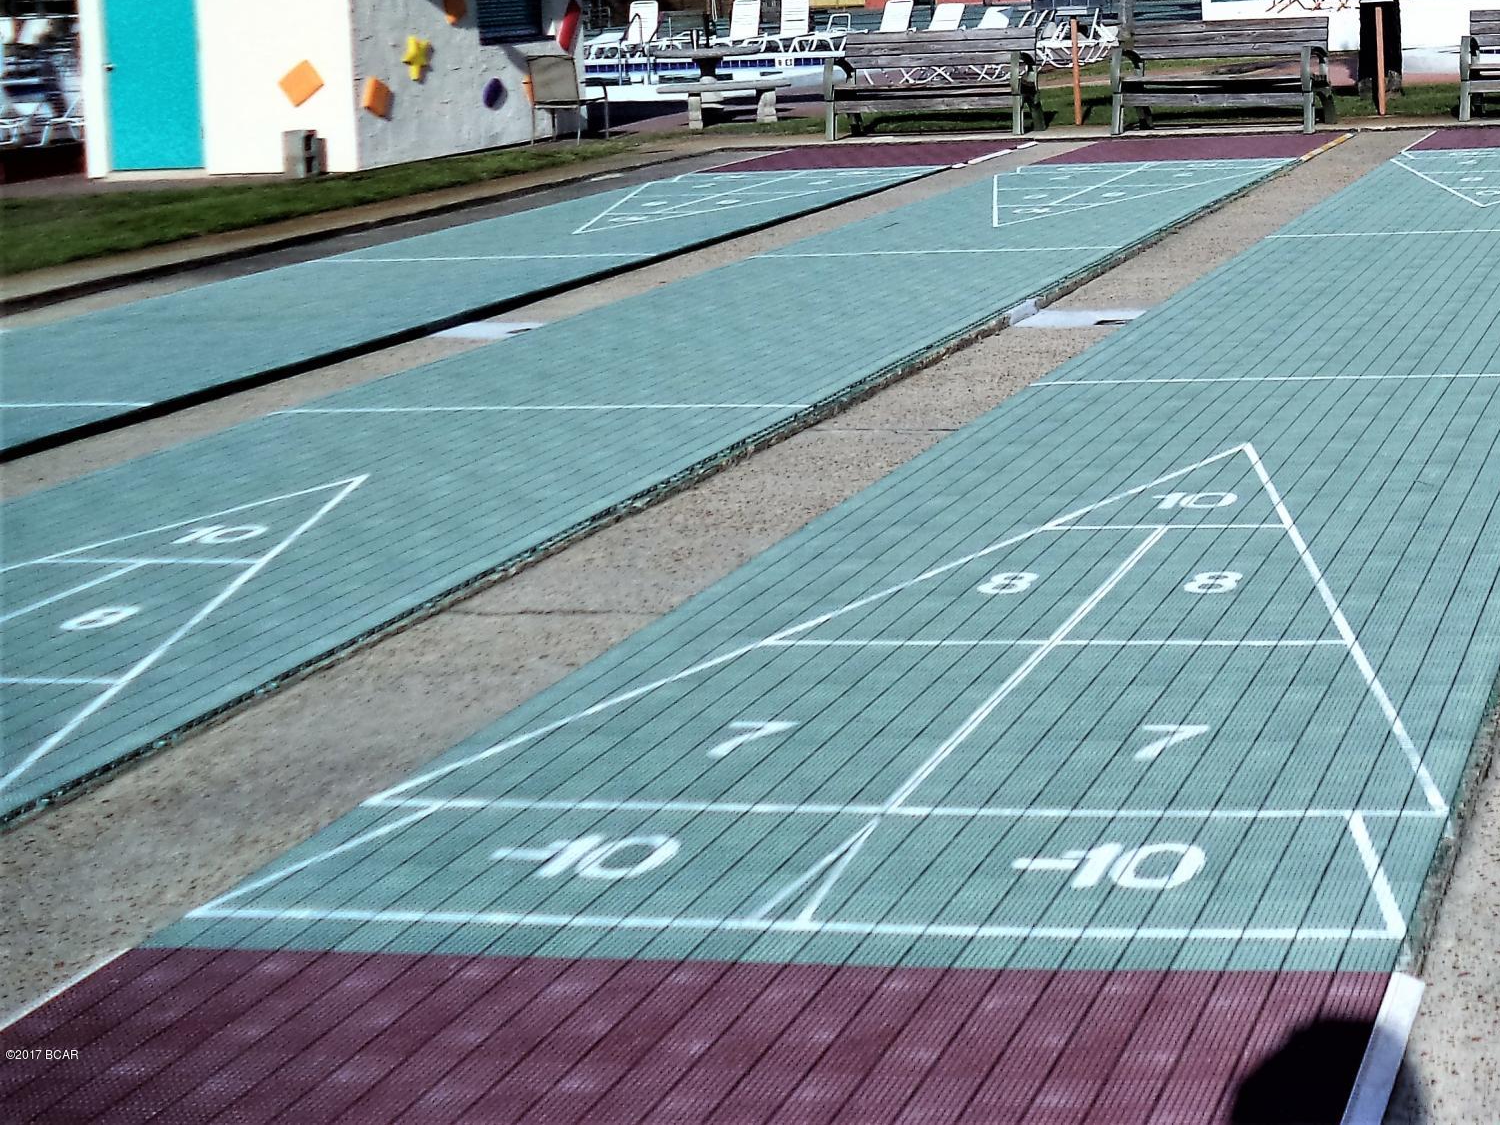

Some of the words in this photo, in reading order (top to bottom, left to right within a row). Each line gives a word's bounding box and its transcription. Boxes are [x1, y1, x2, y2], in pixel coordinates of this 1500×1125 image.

[1152, 491, 1239, 510] 10
[172, 524, 268, 544] 10
[976, 571, 1040, 595] 8
[1182, 570, 1244, 595] 8
[707, 719, 798, 758] 7
[1133, 723, 1212, 761] 7
